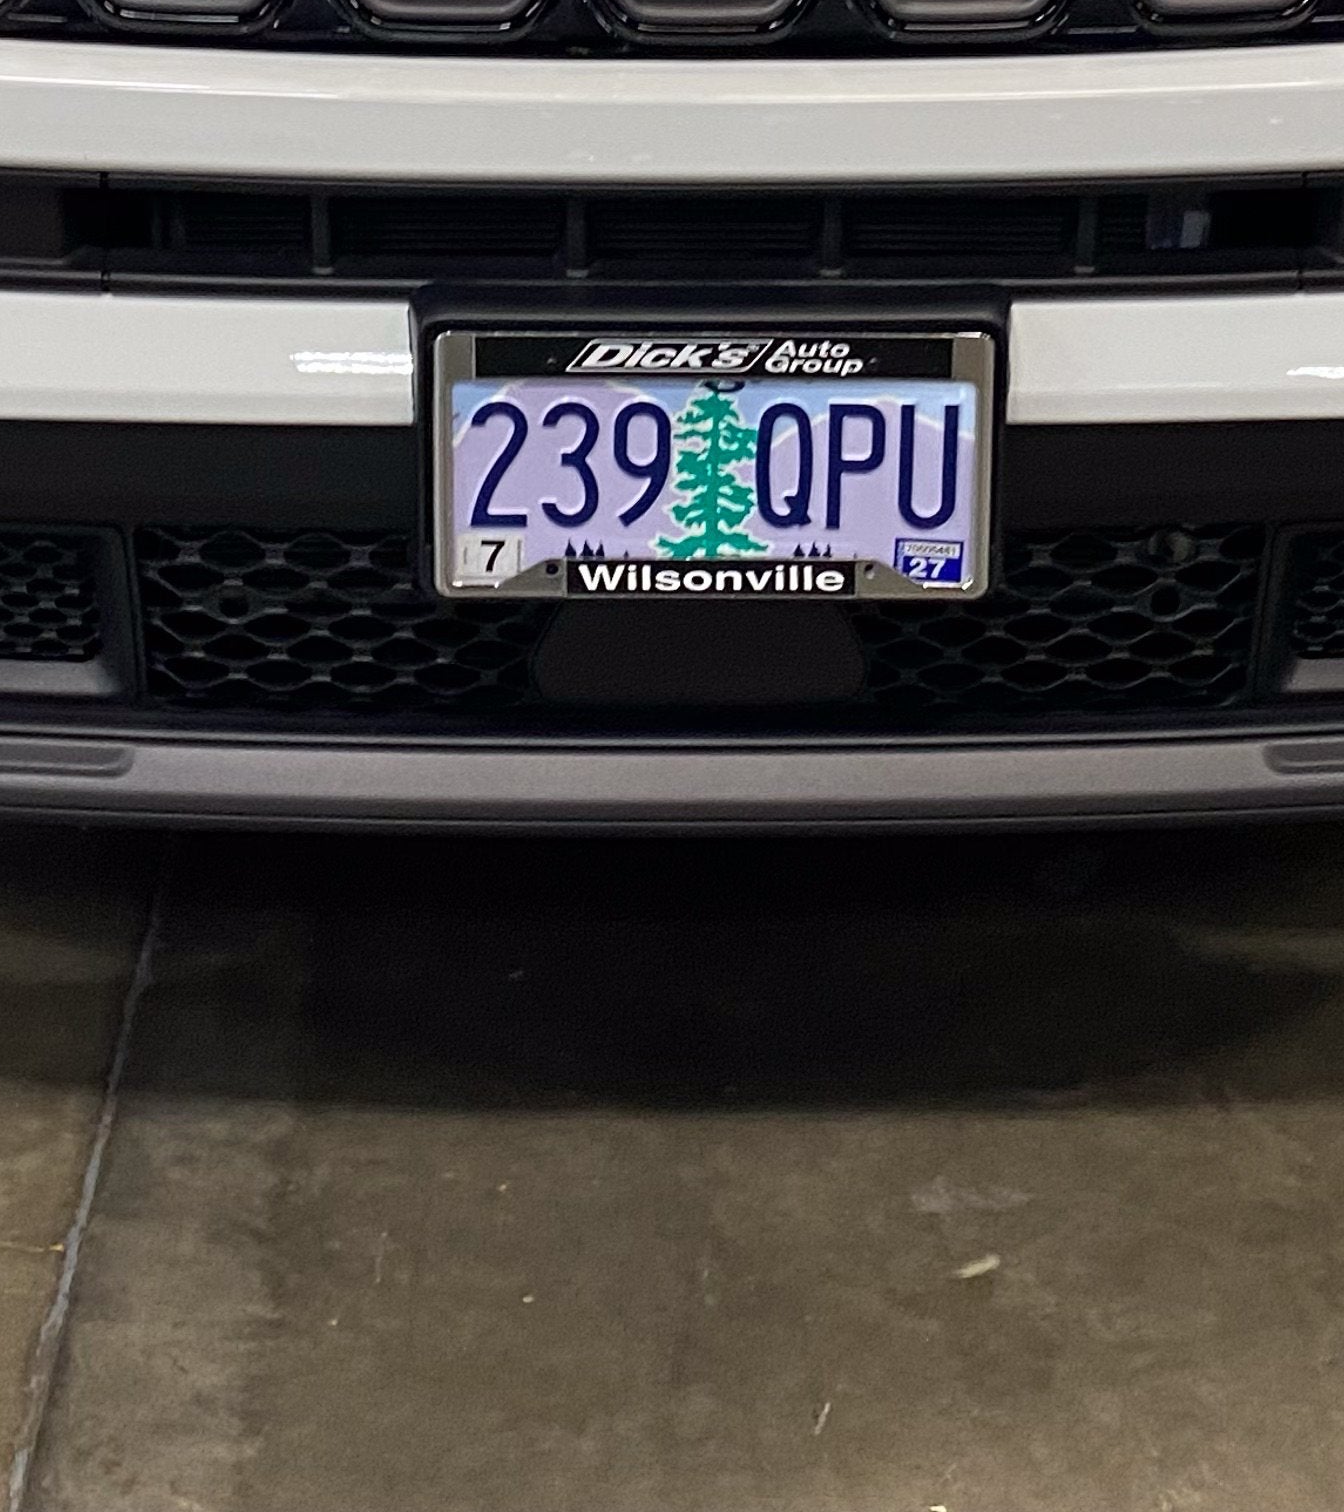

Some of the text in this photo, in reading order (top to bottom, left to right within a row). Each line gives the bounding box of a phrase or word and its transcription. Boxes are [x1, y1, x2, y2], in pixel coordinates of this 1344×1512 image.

[580, 340, 751, 369] Dick's
[773, 339, 851, 359] Auto
[764, 354, 864, 377] Group
[469, 401, 961, 530] 239 QPU
[480, 539, 505, 574] 7
[908, 557, 947, 579] 27
[579, 562, 846, 593] Wilsonville
